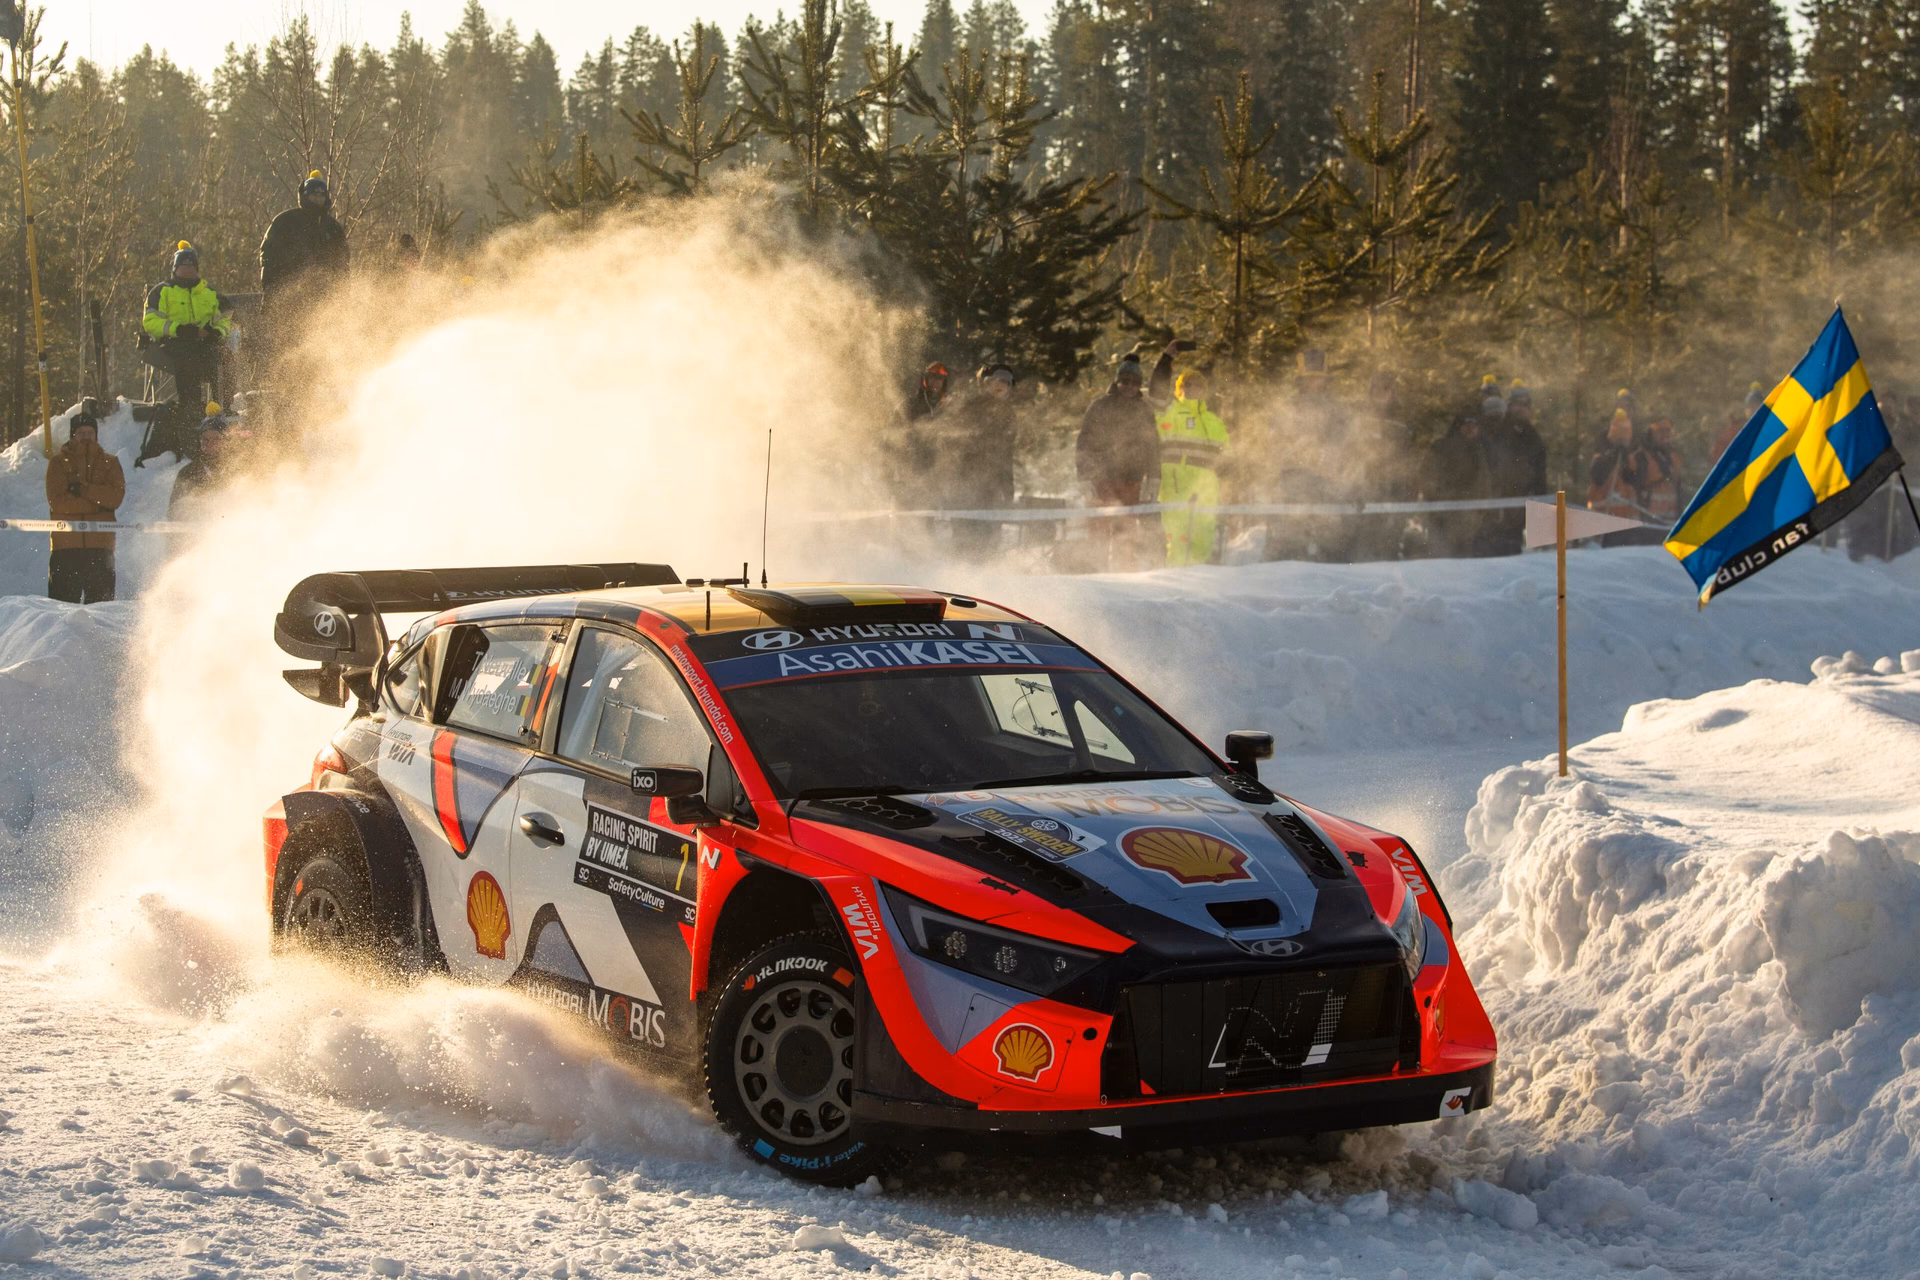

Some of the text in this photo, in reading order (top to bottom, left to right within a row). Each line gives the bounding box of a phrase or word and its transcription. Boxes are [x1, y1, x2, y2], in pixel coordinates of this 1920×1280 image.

[809, 623, 956, 642] HYUNDAI
[778, 641, 1044, 677] AsahiKASEI
[670, 644, 734, 744] motorsport.hyundai.com
[1048, 795, 1240, 819] MOBIS
[585, 836, 600, 859] BY
[592, 811, 658, 853] RACING SPIRIT
[976, 809, 1023, 828] RALLY
[1017, 826, 1081, 855] SWEDEN
[994, 828, 1026, 843] 2025
[700, 845, 720, 870] N
[608, 877, 665, 909] SafetyCulture
[851, 886, 882, 931] HYUNDAI
[587, 988, 667, 1049] MOBIS
